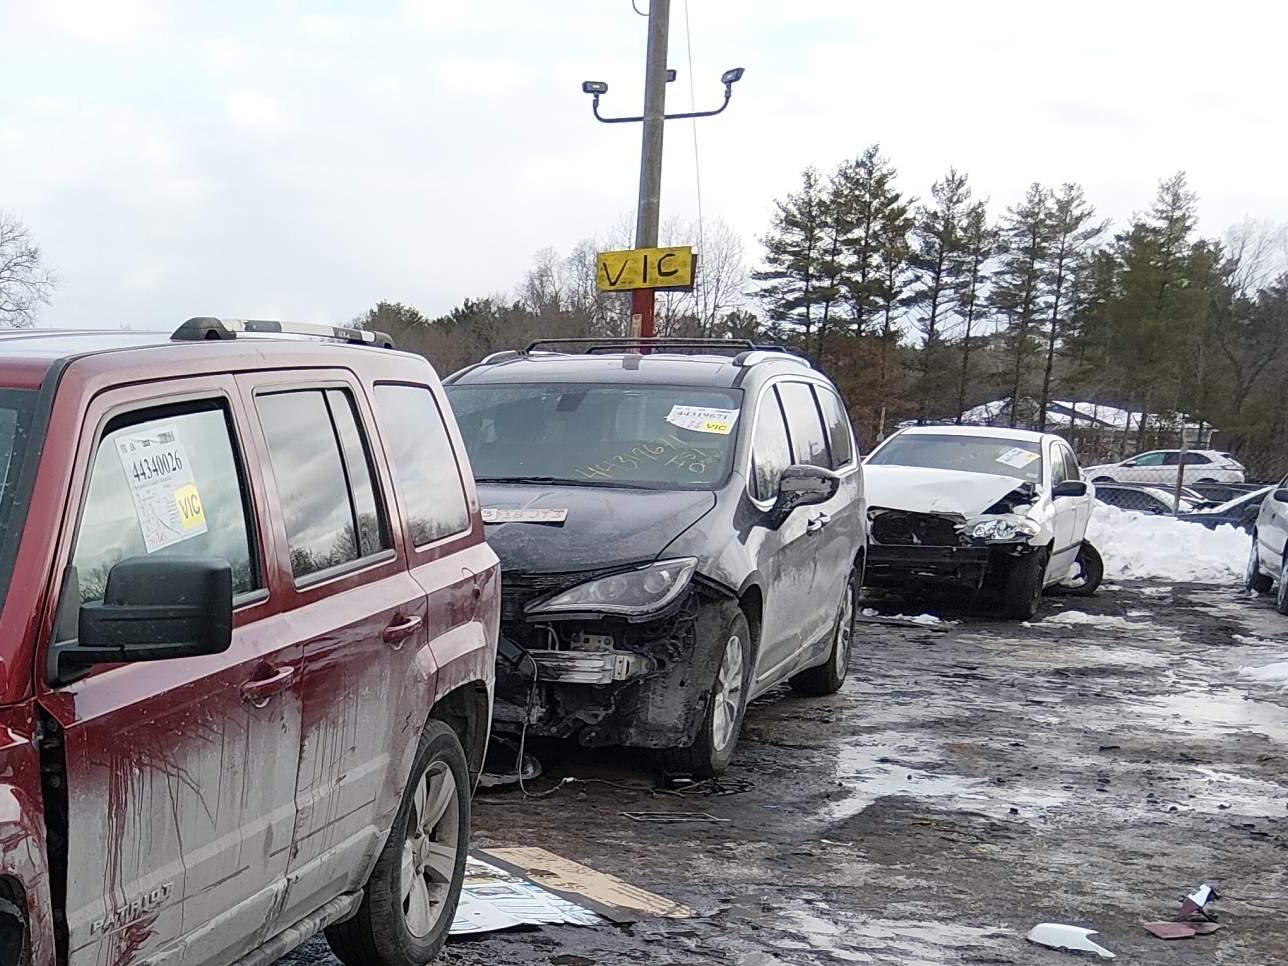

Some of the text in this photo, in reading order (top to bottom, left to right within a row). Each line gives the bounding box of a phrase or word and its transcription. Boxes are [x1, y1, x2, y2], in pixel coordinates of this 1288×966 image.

[603, 253, 679, 286] VIC
[706, 423, 727, 431] VIC
[132, 449, 183, 482] 44340026
[179, 494, 201, 519] VIC
[89, 882, 173, 936] PATRIOT
